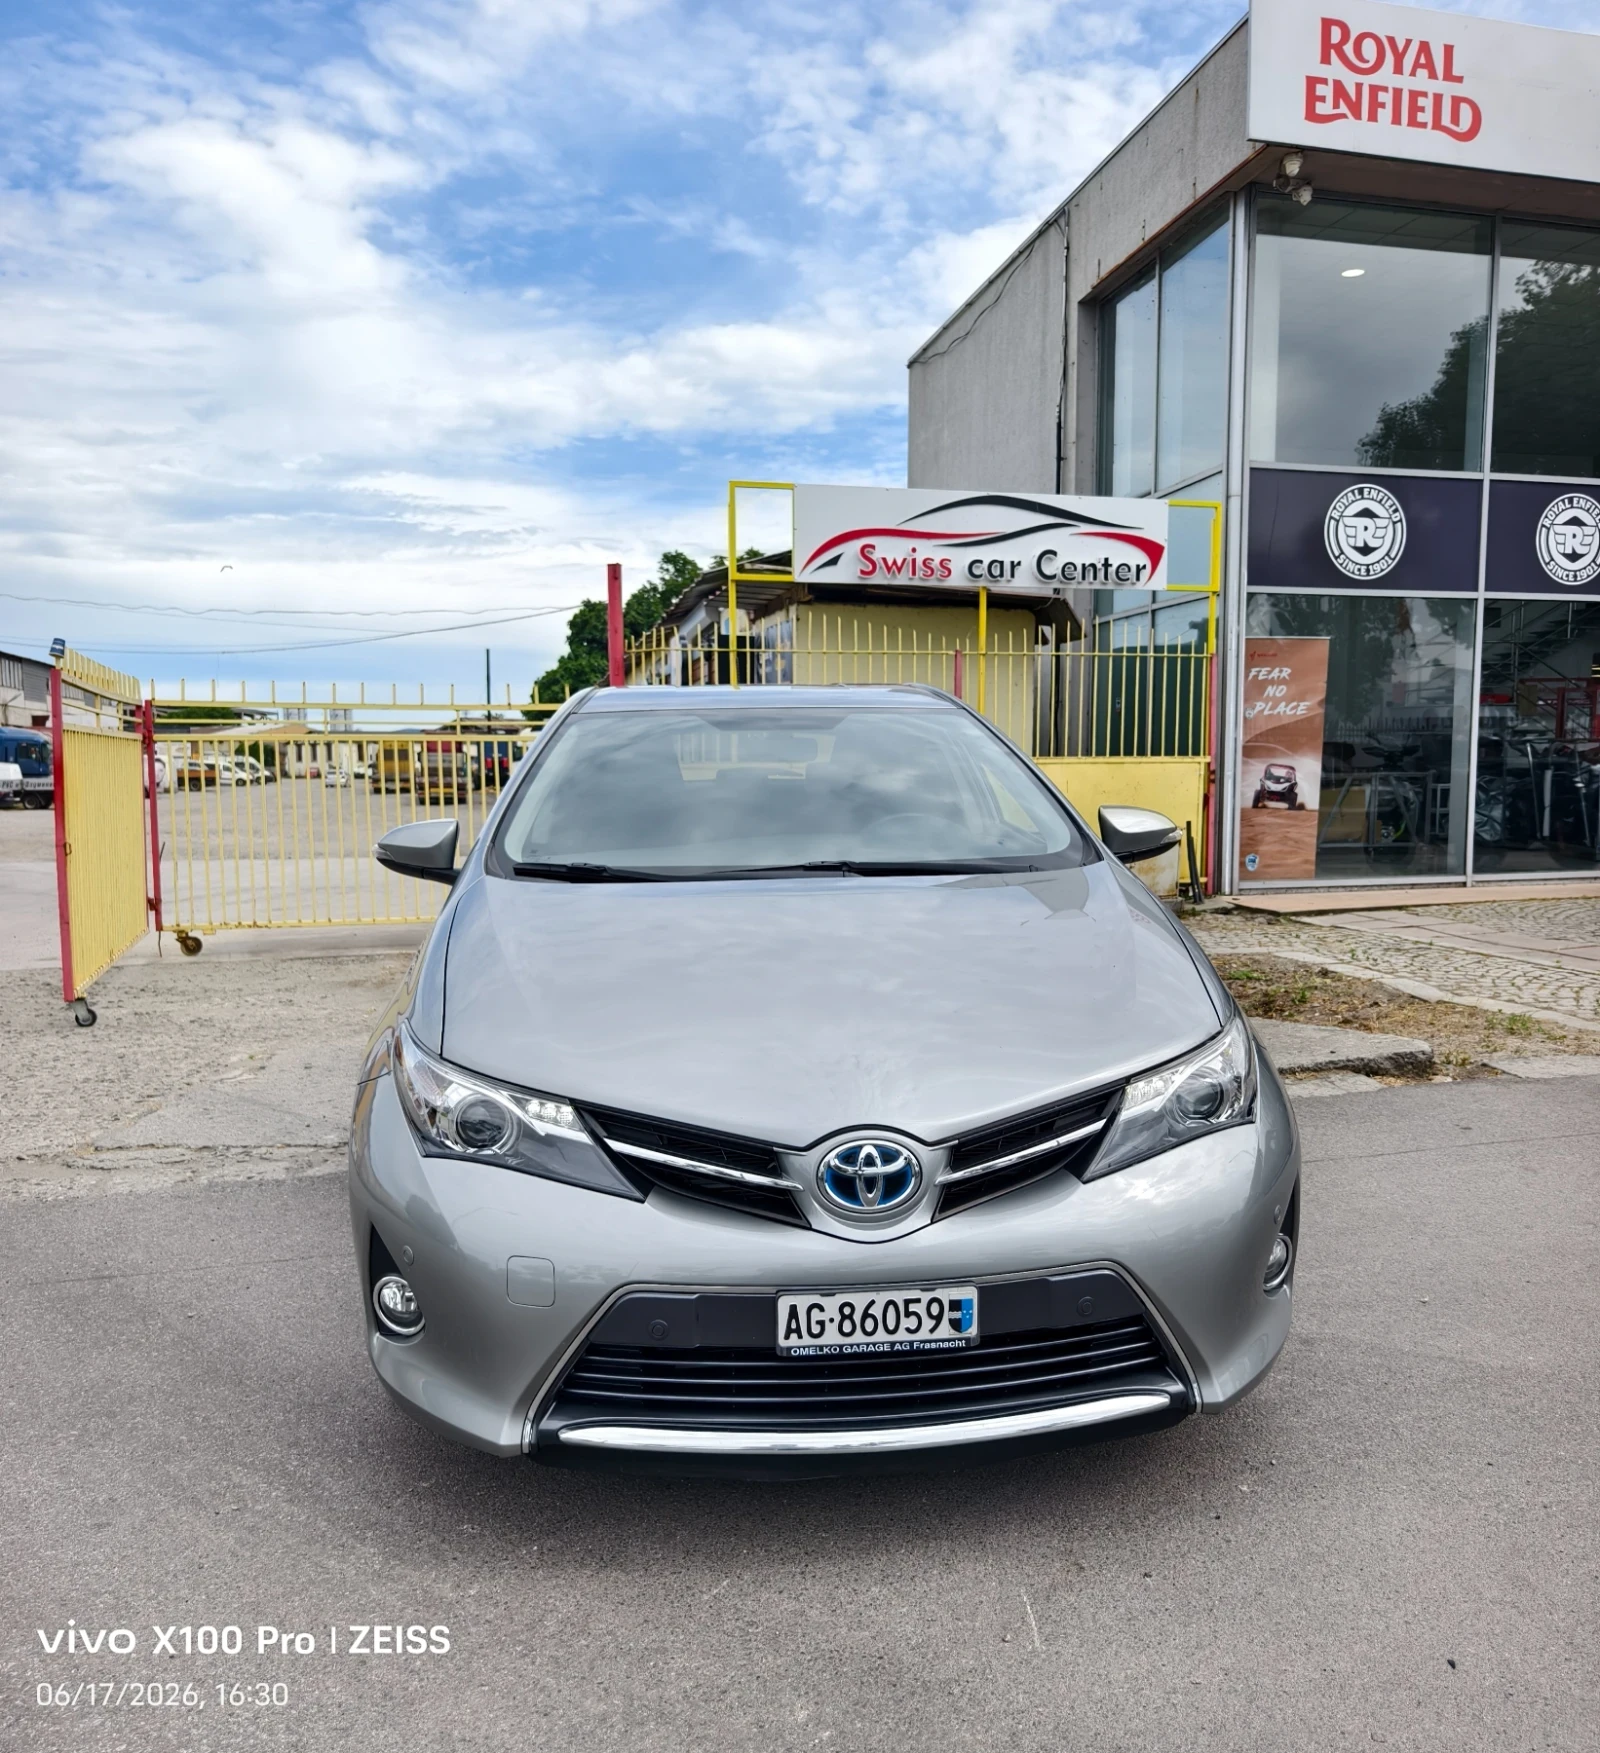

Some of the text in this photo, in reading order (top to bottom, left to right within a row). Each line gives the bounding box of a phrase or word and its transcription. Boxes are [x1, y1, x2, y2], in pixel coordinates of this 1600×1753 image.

[1320, 17, 1464, 84] ROYAL
[1304, 75, 1482, 142] ENFIELD
[1331, 488, 1401, 522] ROYAL ENFIELD
[1542, 497, 1600, 529] ROYAL ENFIEL
[859, 543, 1147, 583] Swiss car Center
[1337, 554, 1393, 576] SINCE 1901
[1547, 560, 1599, 582] SINCE 1901
[1248, 667, 1291, 681] FEAR
[1263, 685, 1287, 698] NO
[1254, 701, 1310, 716] PLACE
[790, 1339, 966, 1356] OMELKO GARAGE AG Frasnacht
